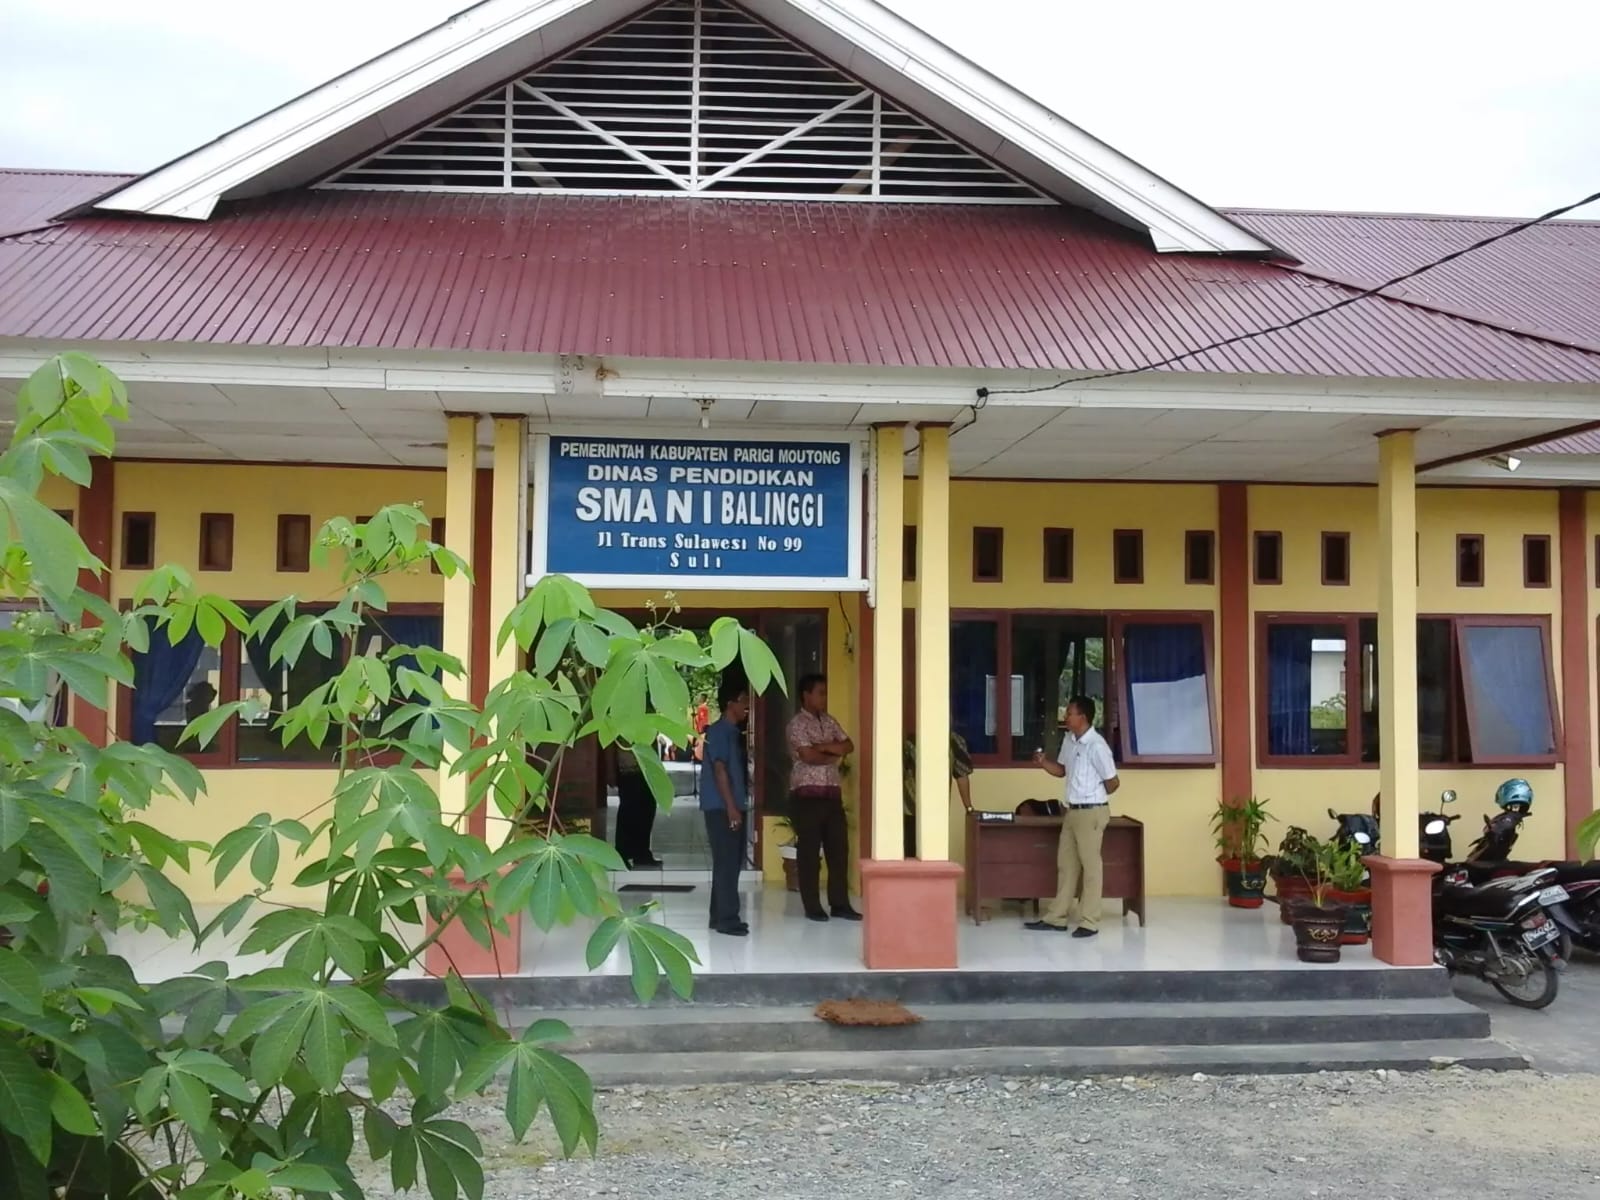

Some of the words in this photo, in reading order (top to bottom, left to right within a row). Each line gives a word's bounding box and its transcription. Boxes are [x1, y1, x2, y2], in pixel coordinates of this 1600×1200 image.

[560, 442, 644, 459] PEMERINTAH
[650, 444, 728, 462] KABUPATEN
[734, 446, 774, 463] PARIGI
[778, 448, 841, 465] MOUTONG
[587, 464, 658, 482] DINAS
[670, 467, 813, 487] PENDIDIKAN
[575, 487, 657, 523] SMA
[666, 489, 693, 524] N
[721, 492, 824, 528] BALINGGI
[621, 532, 667, 549] Trans
[758, 536, 777, 551] No
[783, 537, 802, 552] 99
